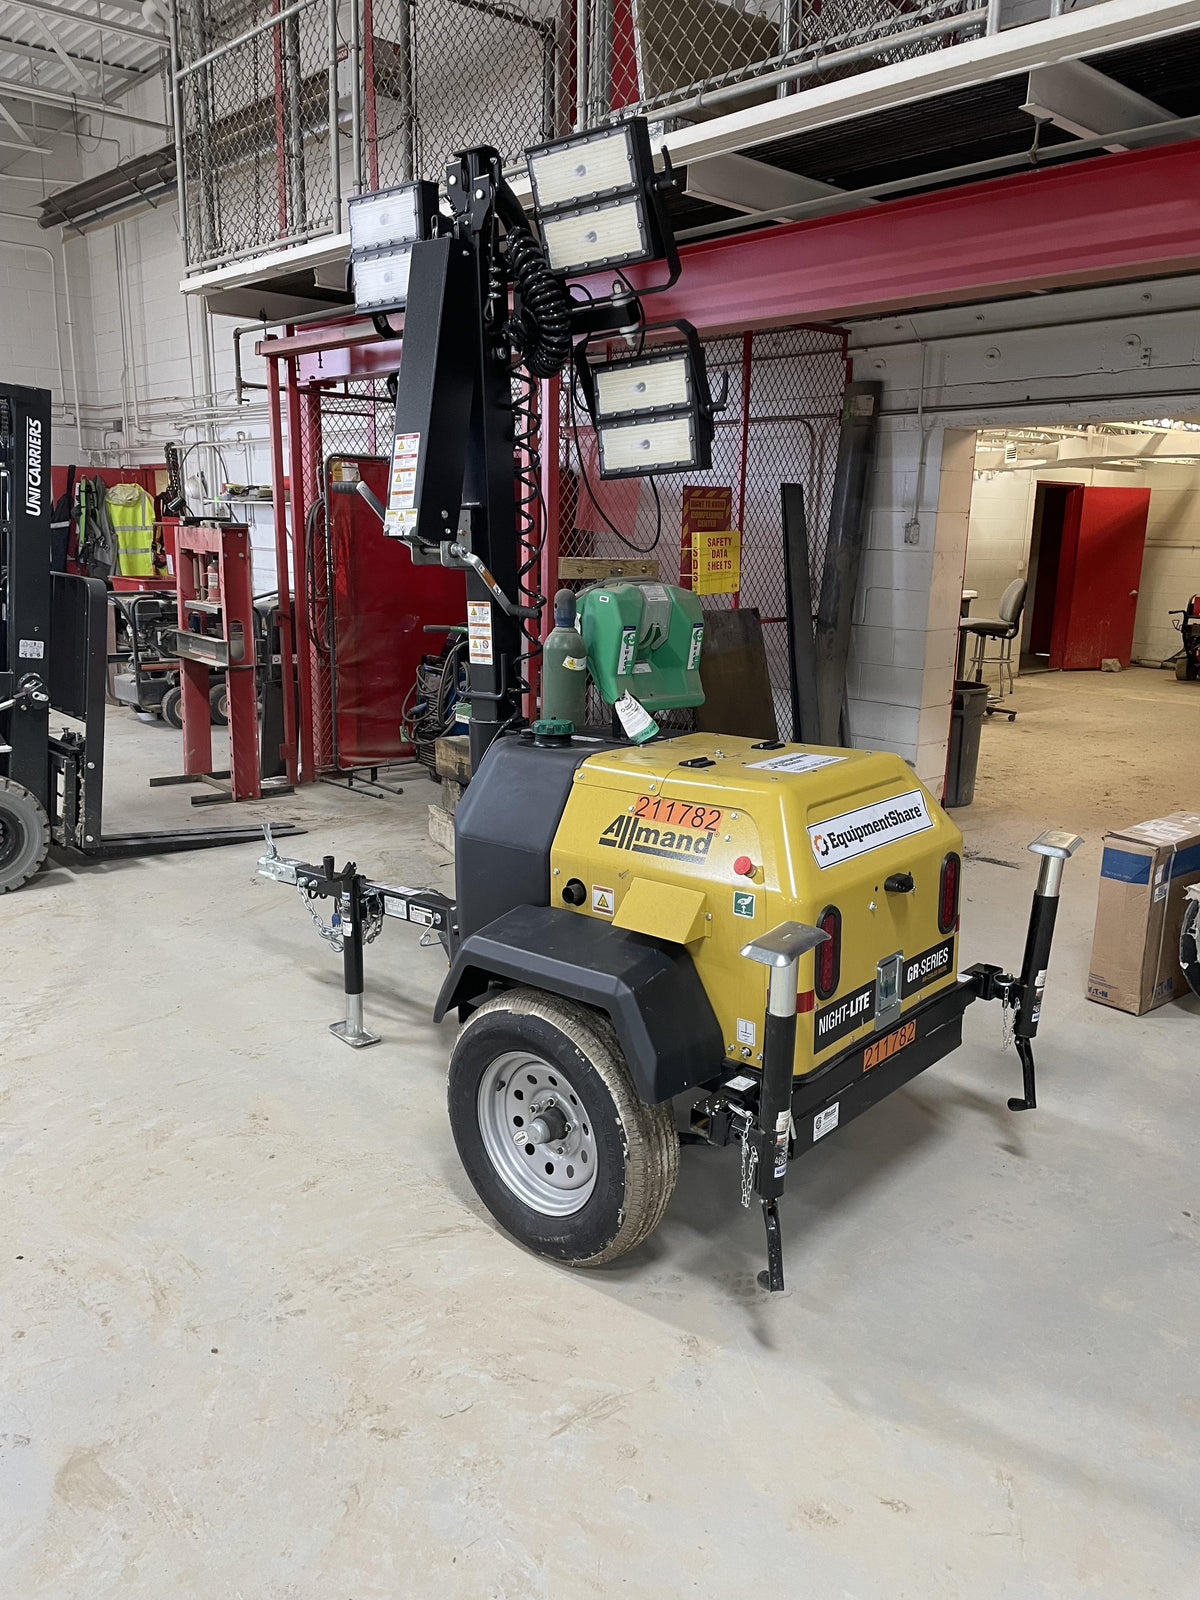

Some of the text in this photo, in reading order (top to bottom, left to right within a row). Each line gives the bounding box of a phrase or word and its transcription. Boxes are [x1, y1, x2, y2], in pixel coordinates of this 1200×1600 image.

[26, 416, 41, 516] UNICARRIERS
[707, 537, 732, 547] SAFETY
[711, 549, 728, 559] DATA
[707, 560, 732, 571] SHEETS
[634, 796, 721, 831] 211782
[827, 805, 922, 849] EquipmentShare
[601, 814, 714, 856] Allmand
[907, 947, 949, 983] GR-SERIES
[818, 992, 870, 1036] NIGHT-LITE
[864, 1021, 915, 1070] 211782
